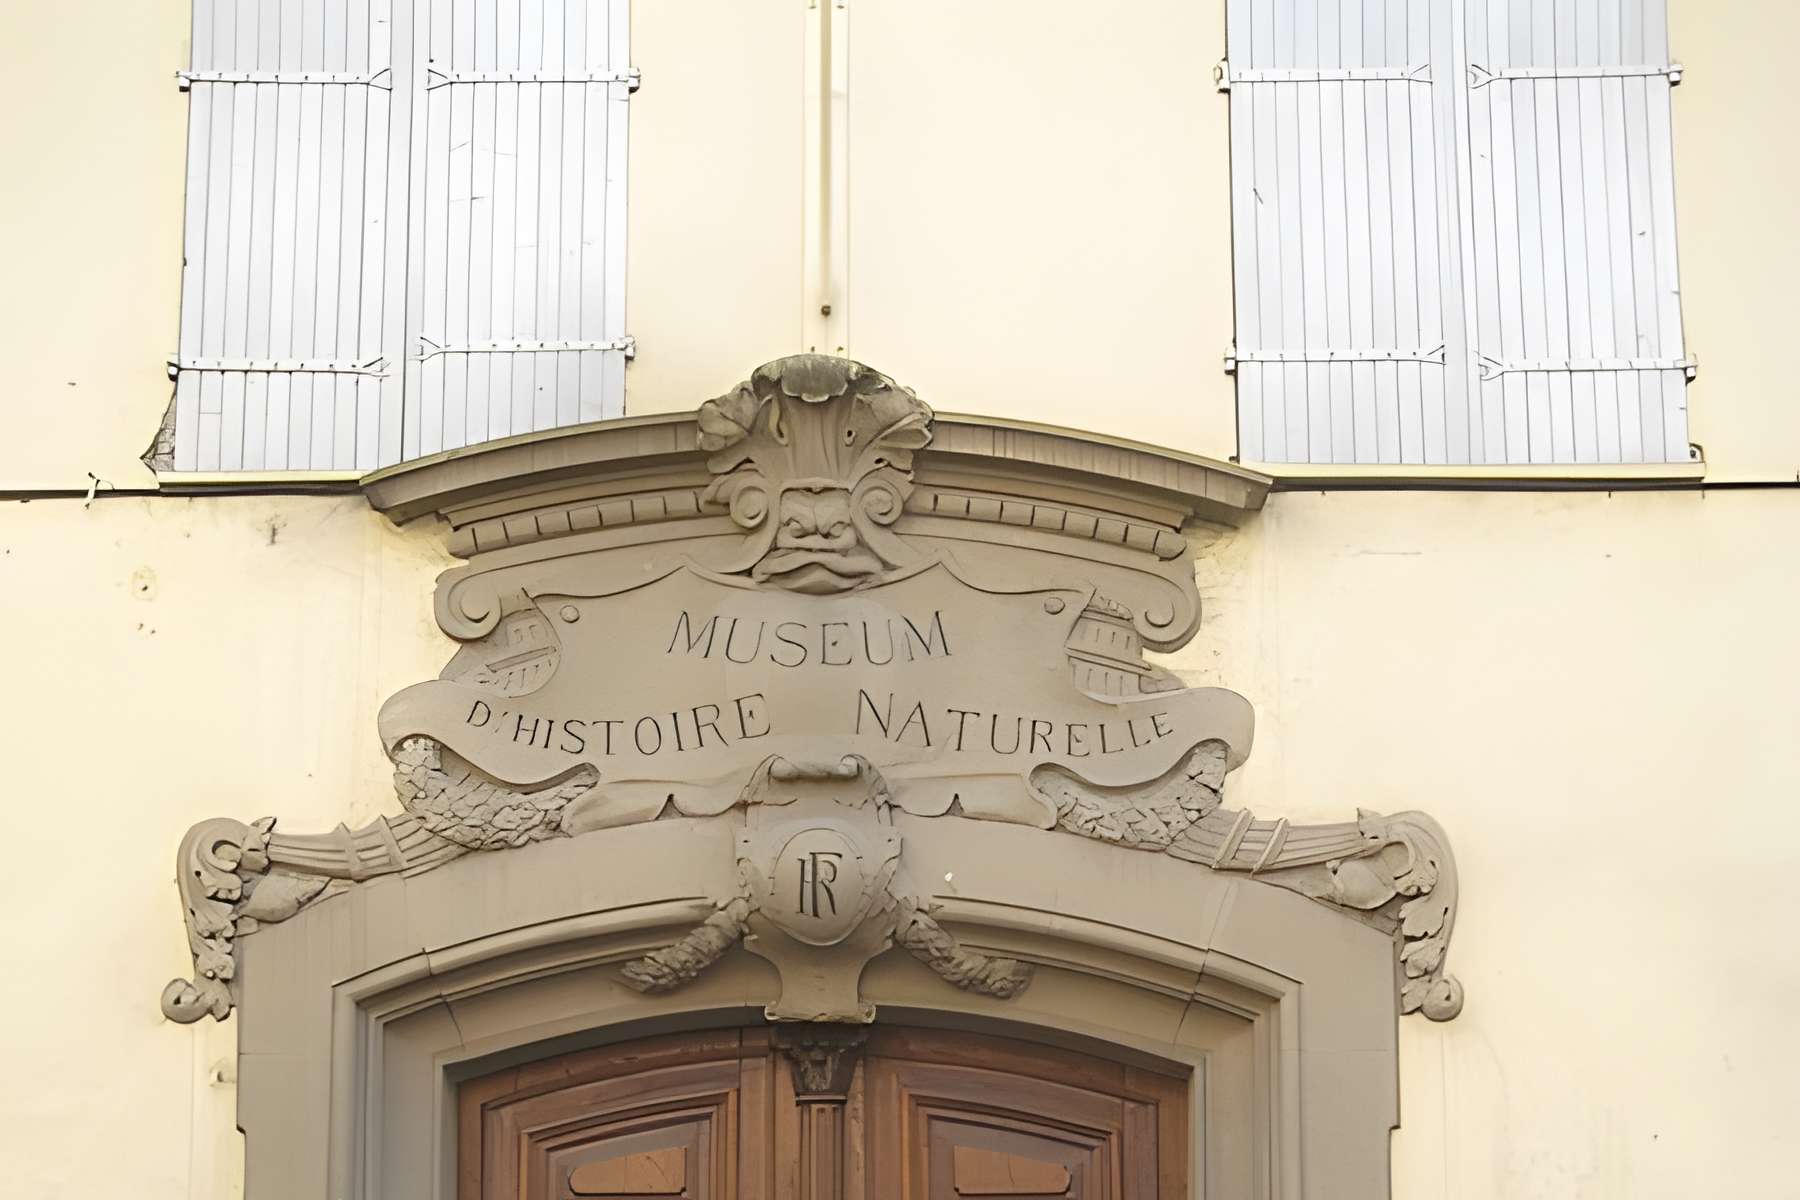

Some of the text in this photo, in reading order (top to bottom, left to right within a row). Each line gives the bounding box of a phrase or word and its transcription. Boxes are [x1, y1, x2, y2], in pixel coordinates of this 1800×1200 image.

[666, 610, 953, 668] MUSEUM
[466, 688, 1174, 757] D'HISTOIRE NATURELLE
